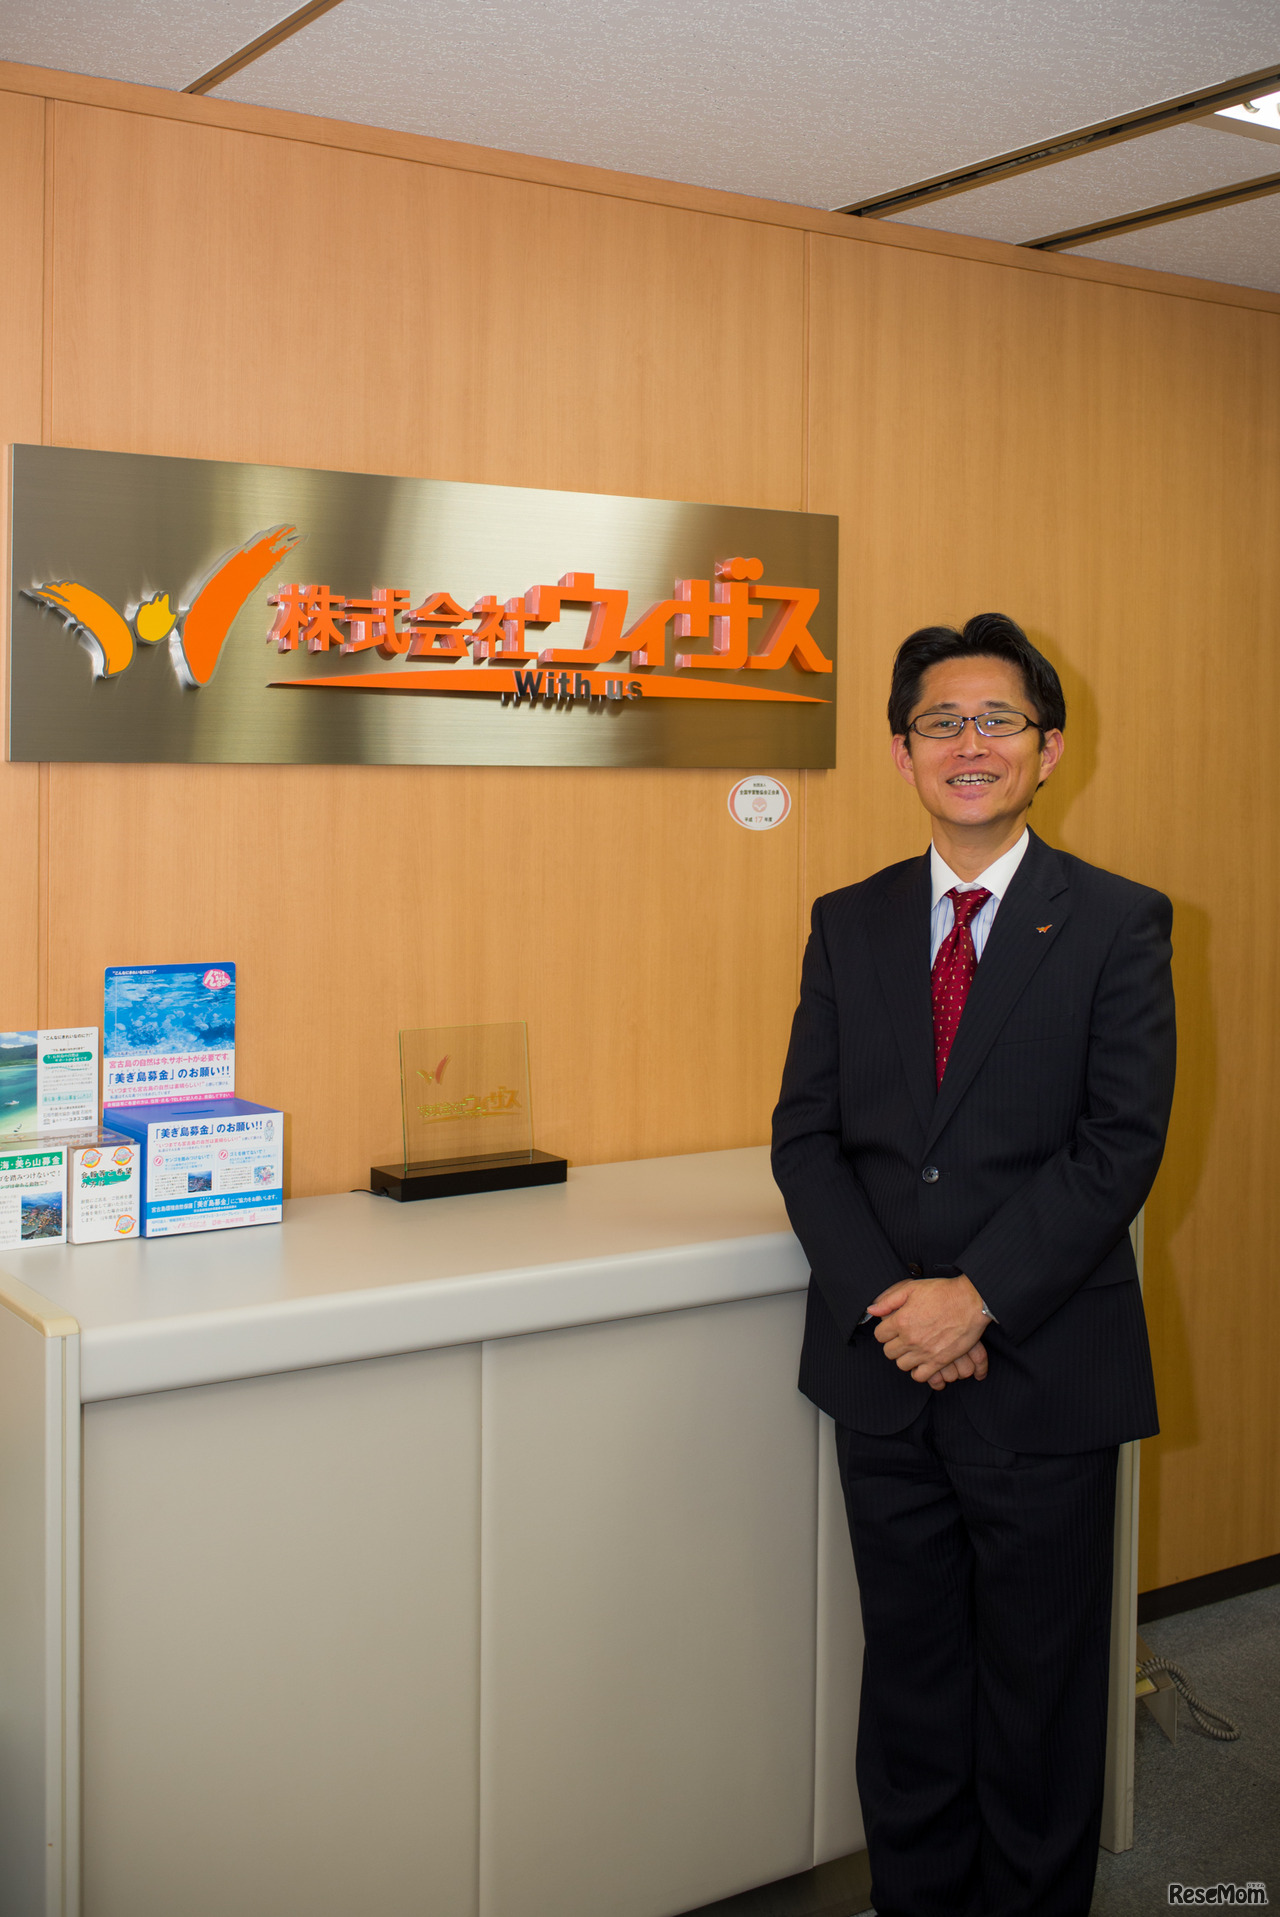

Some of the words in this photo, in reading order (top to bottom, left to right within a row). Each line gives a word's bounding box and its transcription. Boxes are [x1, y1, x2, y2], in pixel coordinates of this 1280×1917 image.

[268, 556, 832, 673] 株式会社ウィザス
[513, 670, 591, 699] With
[605, 680, 643, 700] us
